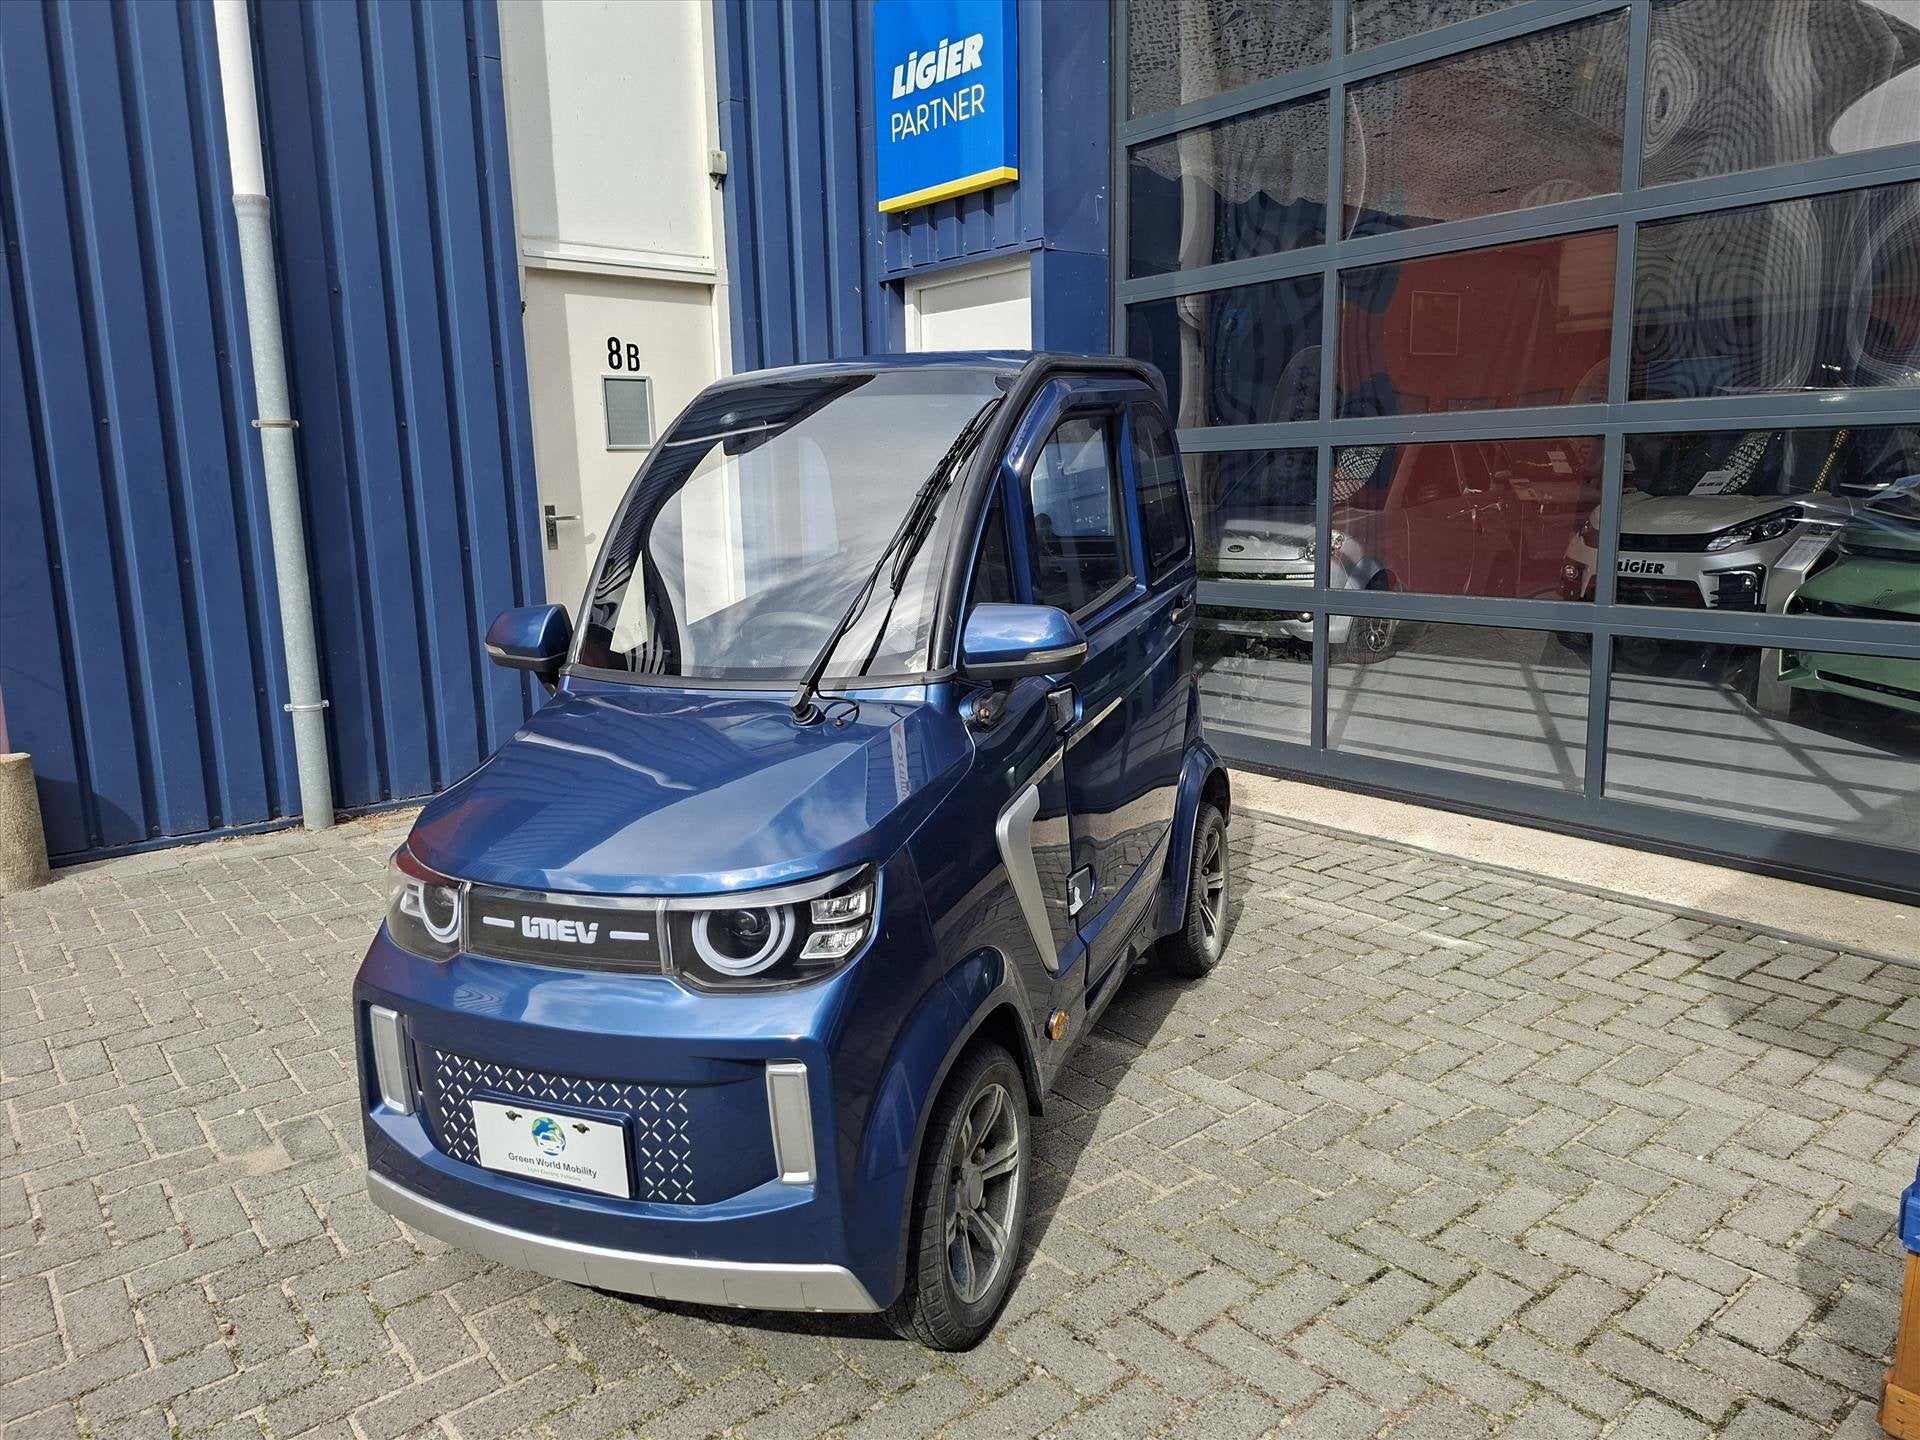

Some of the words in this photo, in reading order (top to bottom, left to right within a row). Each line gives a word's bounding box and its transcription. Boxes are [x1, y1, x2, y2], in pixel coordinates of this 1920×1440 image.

[891, 84, 985, 143] PARTNER
[508, 1152, 535, 1164] Green
[536, 1157, 561, 1169] World
[563, 1163, 597, 1179] Mobility
